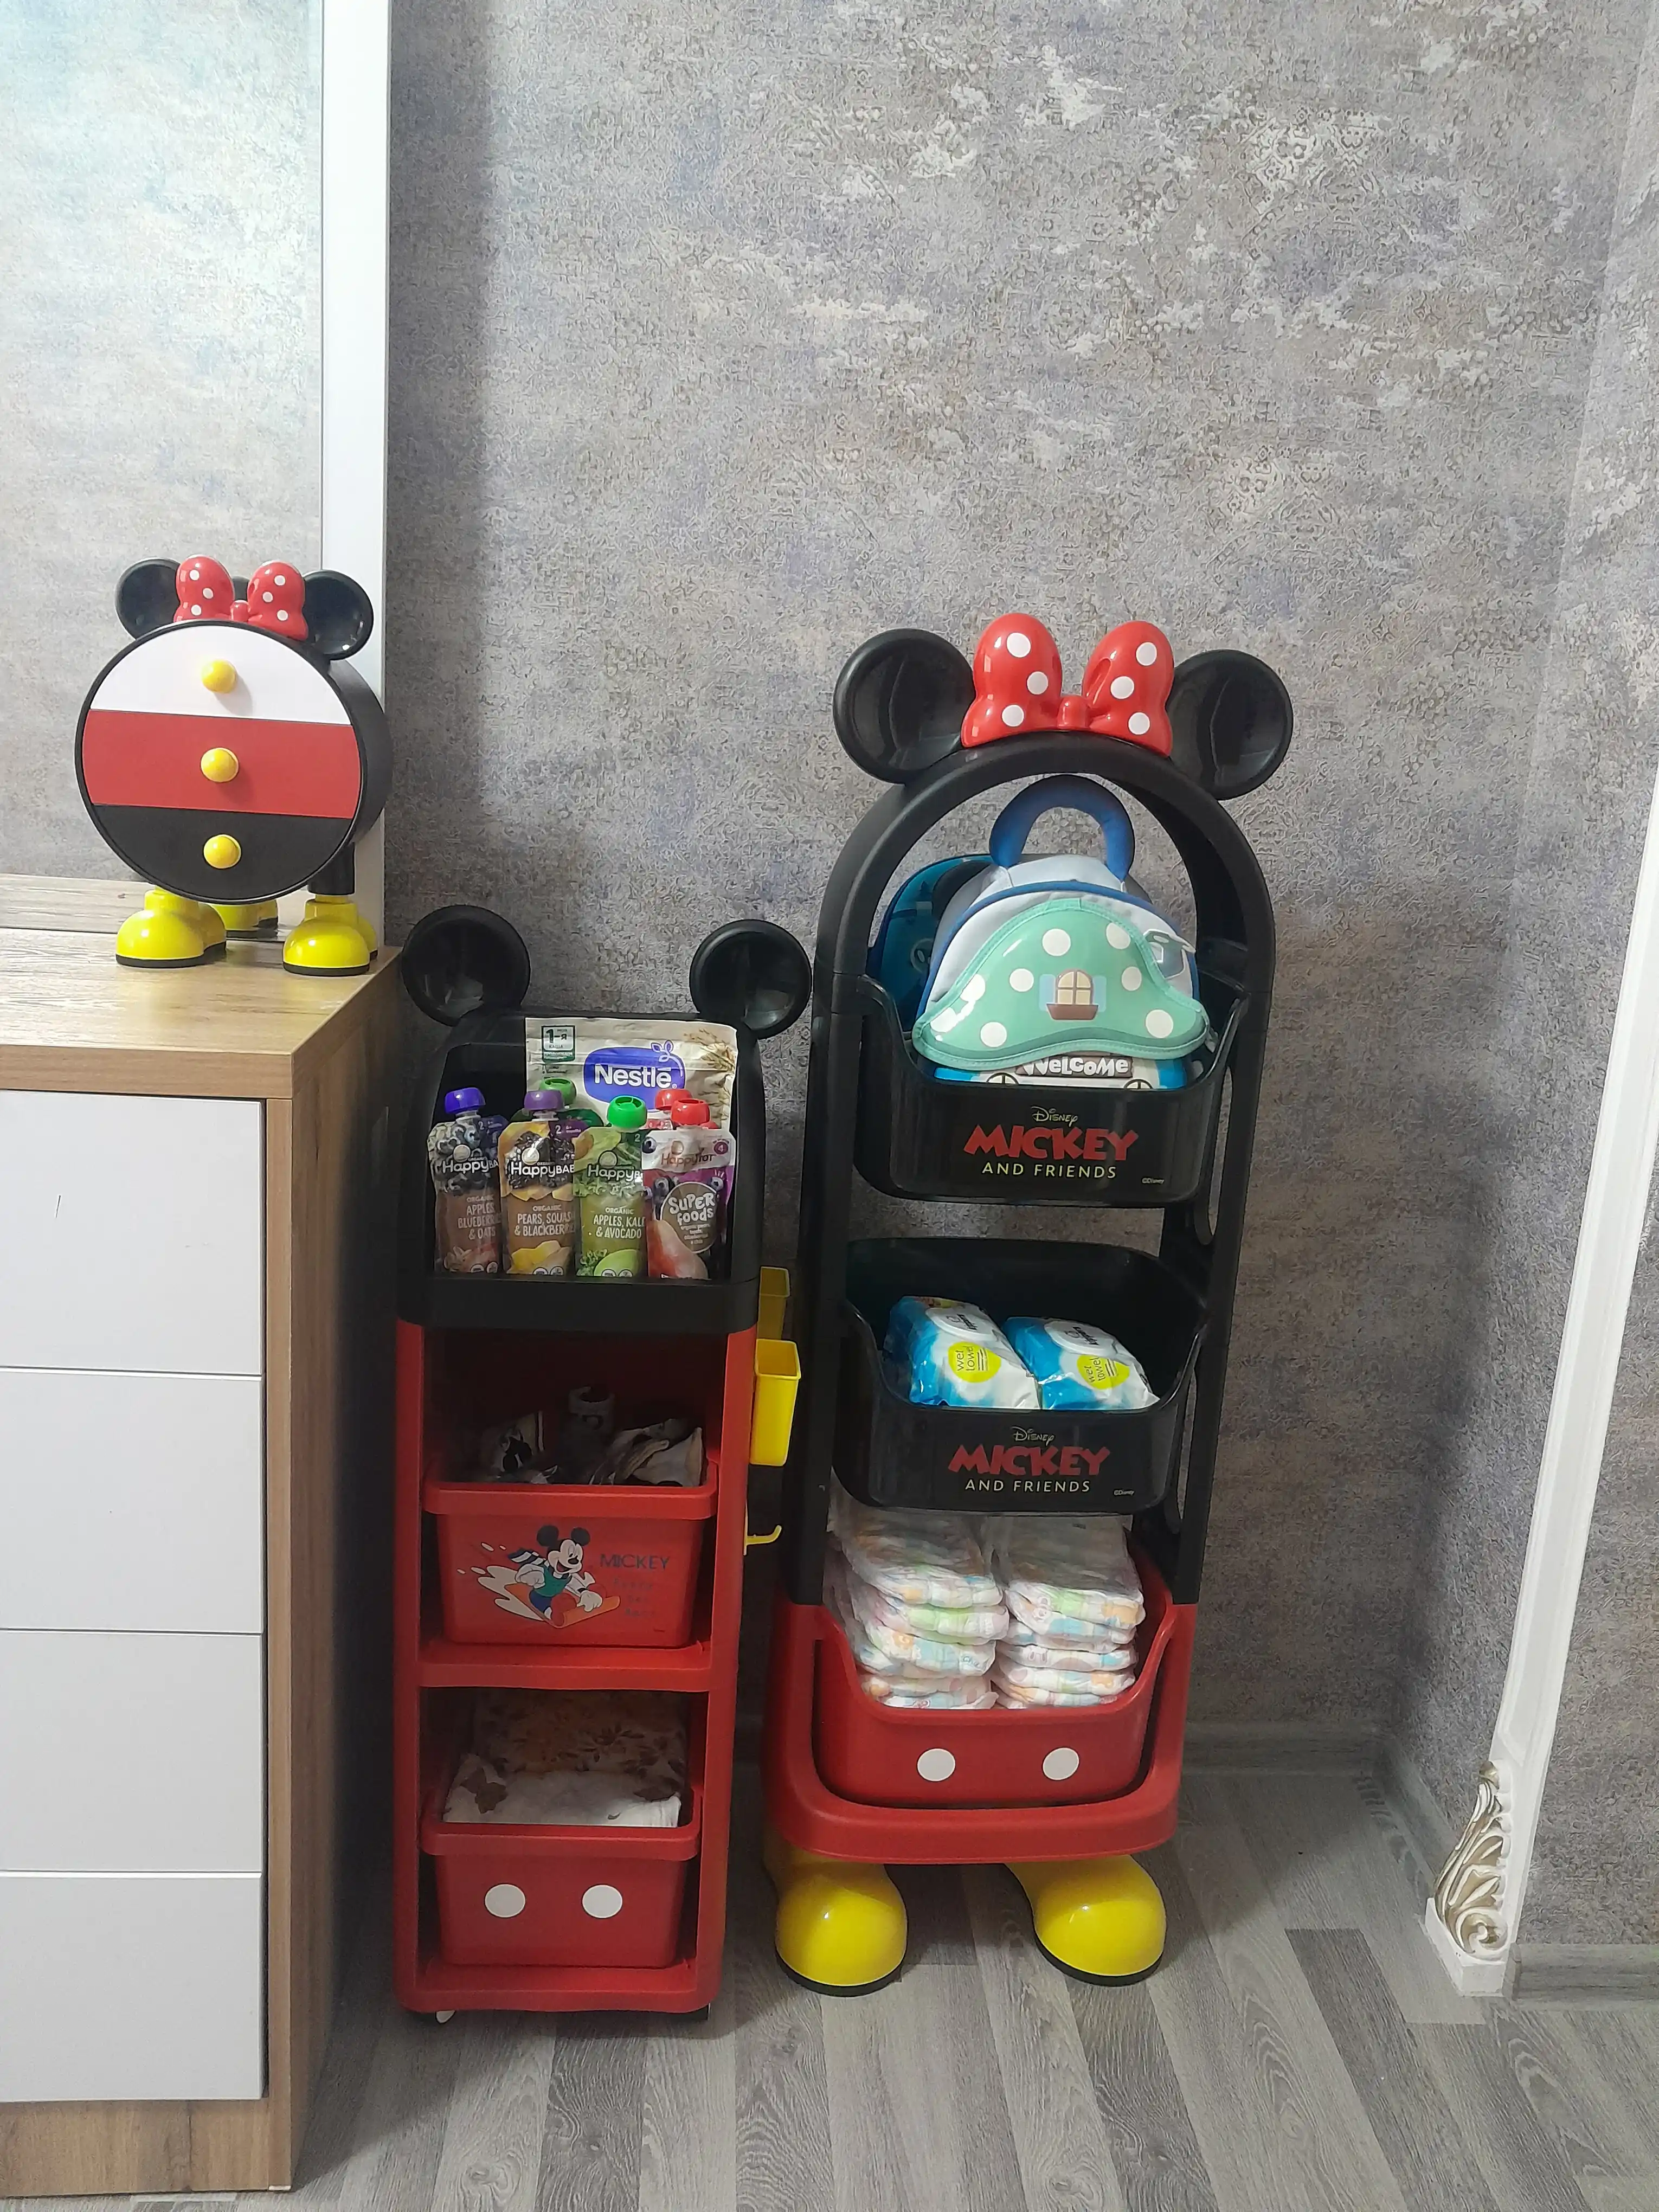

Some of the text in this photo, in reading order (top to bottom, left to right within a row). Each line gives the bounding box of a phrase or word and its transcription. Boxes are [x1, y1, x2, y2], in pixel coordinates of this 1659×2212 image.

[595, 1063, 672, 1089] Nestlé
[555, 1125, 562, 1134] 2
[634, 1133, 640, 1142] 2
[963, 1124, 1139, 1160] MICKEY
[442, 1159, 498, 1174] HappyBA
[511, 1161, 575, 1178] HappyBAB
[982, 1162, 1116, 1179] AND FRIENDS
[605, 1207, 634, 1215] ORGANIC
[593, 1214, 624, 1228] APPLES,
[468, 1226, 496, 1240] & OATS
[515, 1225, 520, 1236] &
[596, 1226, 642, 1239] & AVOCADO
[948, 1444, 1110, 1476] MICKEY
[965, 1479, 1090, 1493] AND FRIENDS
[600, 1554, 670, 1570] MICKEY
